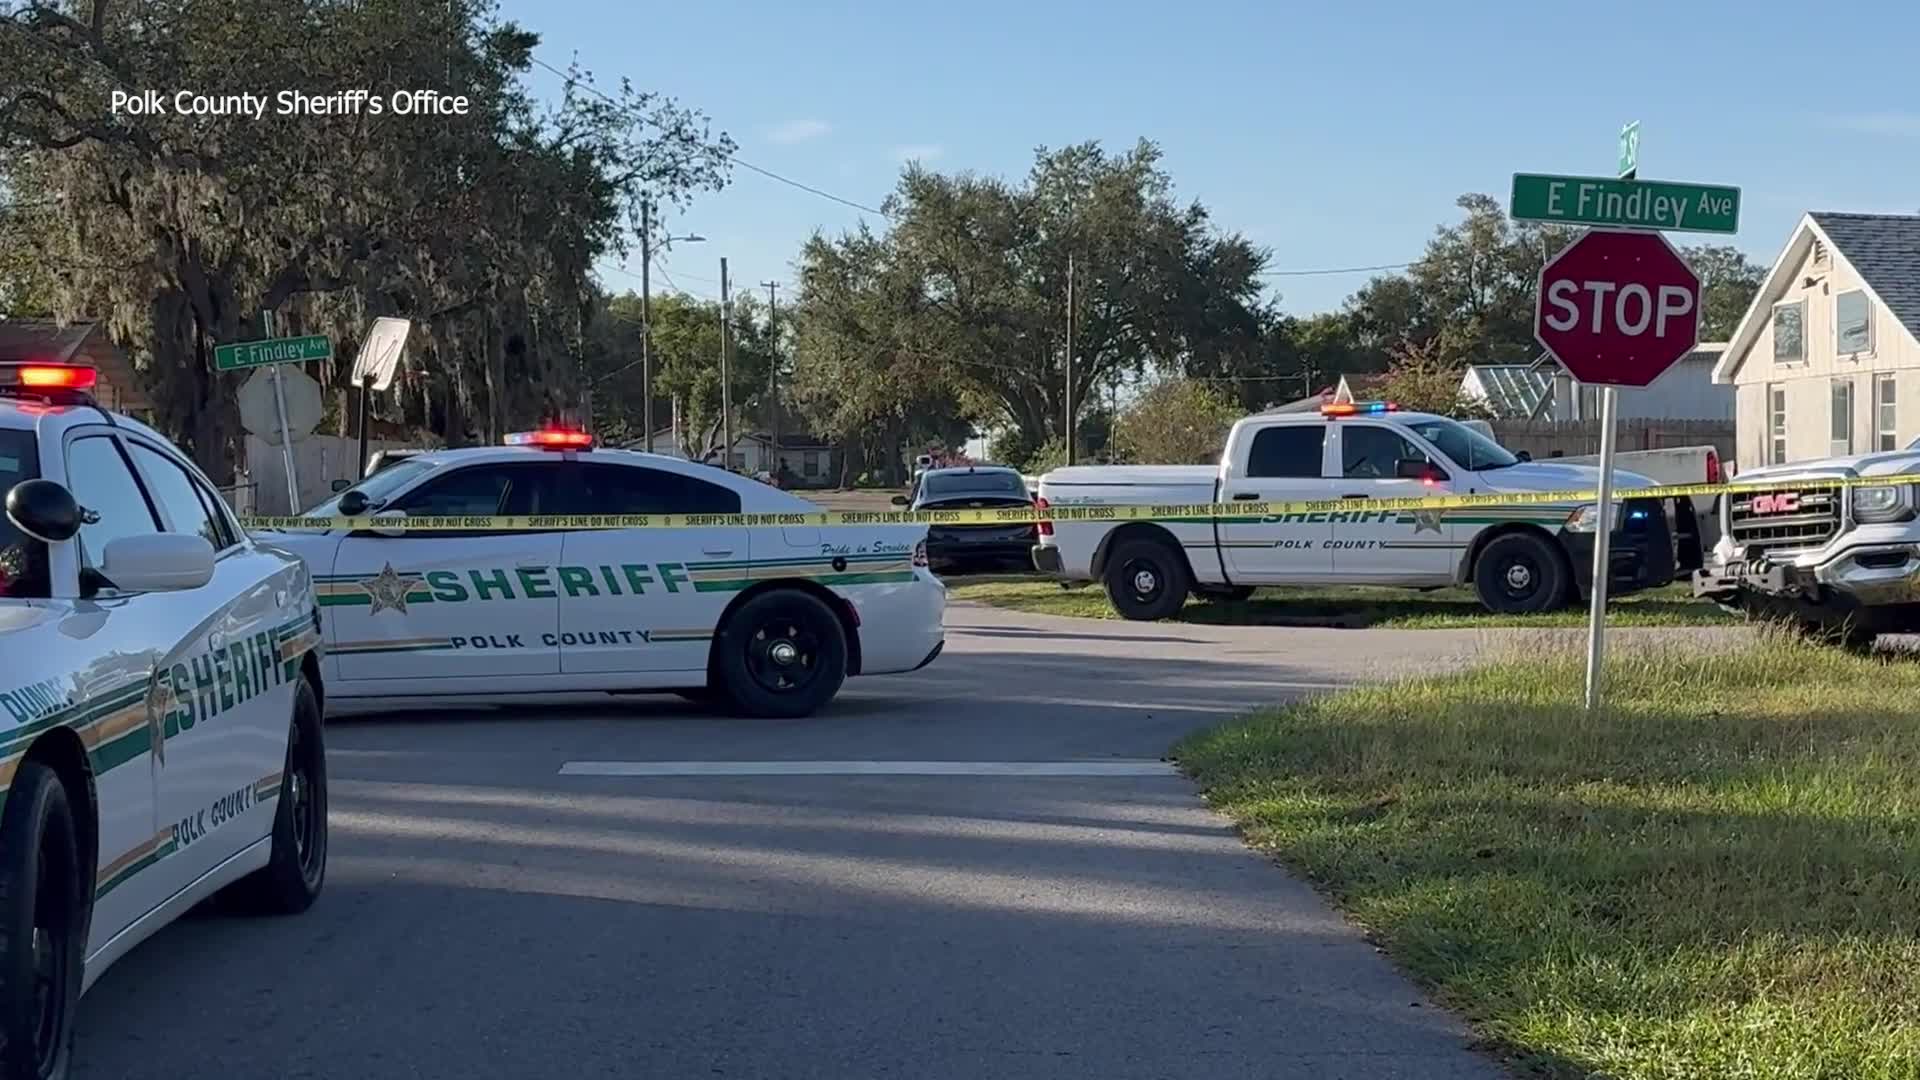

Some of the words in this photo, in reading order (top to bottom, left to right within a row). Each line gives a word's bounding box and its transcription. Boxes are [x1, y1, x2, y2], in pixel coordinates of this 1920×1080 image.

[1548, 182, 1566, 215] E
[1577, 183, 1688, 228] Findley
[1697, 191, 1732, 216] Ave
[1545, 279, 1694, 337] STOP
[234, 350, 244, 365] E
[250, 343, 305, 362] Findley
[309, 338, 328, 350] Ave
[1151, 504, 1190, 516] SHERIFF'S
[1192, 504, 1210, 516] LINE
[1212, 503, 1223, 515] DO
[1225, 503, 1241, 514] NOT
[1243, 502, 1269, 513] CROSS
[1347, 499, 1364, 510] LINE
[1366, 498, 1378, 509] DO
[1380, 498, 1395, 508] NOT
[1397, 497, 1424, 507] CROSS
[1753, 493, 1799, 513] GMC
[685, 515, 726, 526] SHERIFF'S
[728, 515, 745, 525] LINE
[747, 514, 758, 525] DO
[760, 514, 776, 525] NOT
[778, 514, 805, 524] CROSS
[841, 512, 881, 524] SHERIFF'S
[883, 512, 900, 523] LINE
[903, 512, 914, 523] DO
[916, 511, 932, 522] NOT
[934, 511, 960, 522] CROSS
[996, 509, 1036, 520] SHERIFF'S
[1038, 509, 1056, 520] LINE
[1058, 508, 1069, 519] DO
[1071, 508, 1086, 519] NOT
[1088, 507, 1115, 518] CROSS
[370, 517, 411, 528] SHERIFF'S
[412, 517, 430, 528] LINE
[433, 517, 444, 528] DO
[446, 517, 462, 528] NOT
[464, 517, 492, 528] CROSS
[528, 517, 568, 527] SHERIFF'S
[570, 517, 588, 527] LINE
[591, 517, 602, 526] DO
[604, 516, 620, 526] NOT
[622, 516, 648, 526] CROSS
[821, 543, 851, 555] Pride
[873, 541, 910, 553] Service
[1275, 540, 1314, 549] POLK
[1323, 540, 1386, 549] COUNTY
[426, 562, 689, 603] SHERIFF
[452, 634, 525, 649] POLK
[542, 630, 652, 646] COUNTY
[170, 626, 285, 732] SHERIFF
[172, 808, 206, 851] POLK
[211, 781, 261, 827] COUNTY
